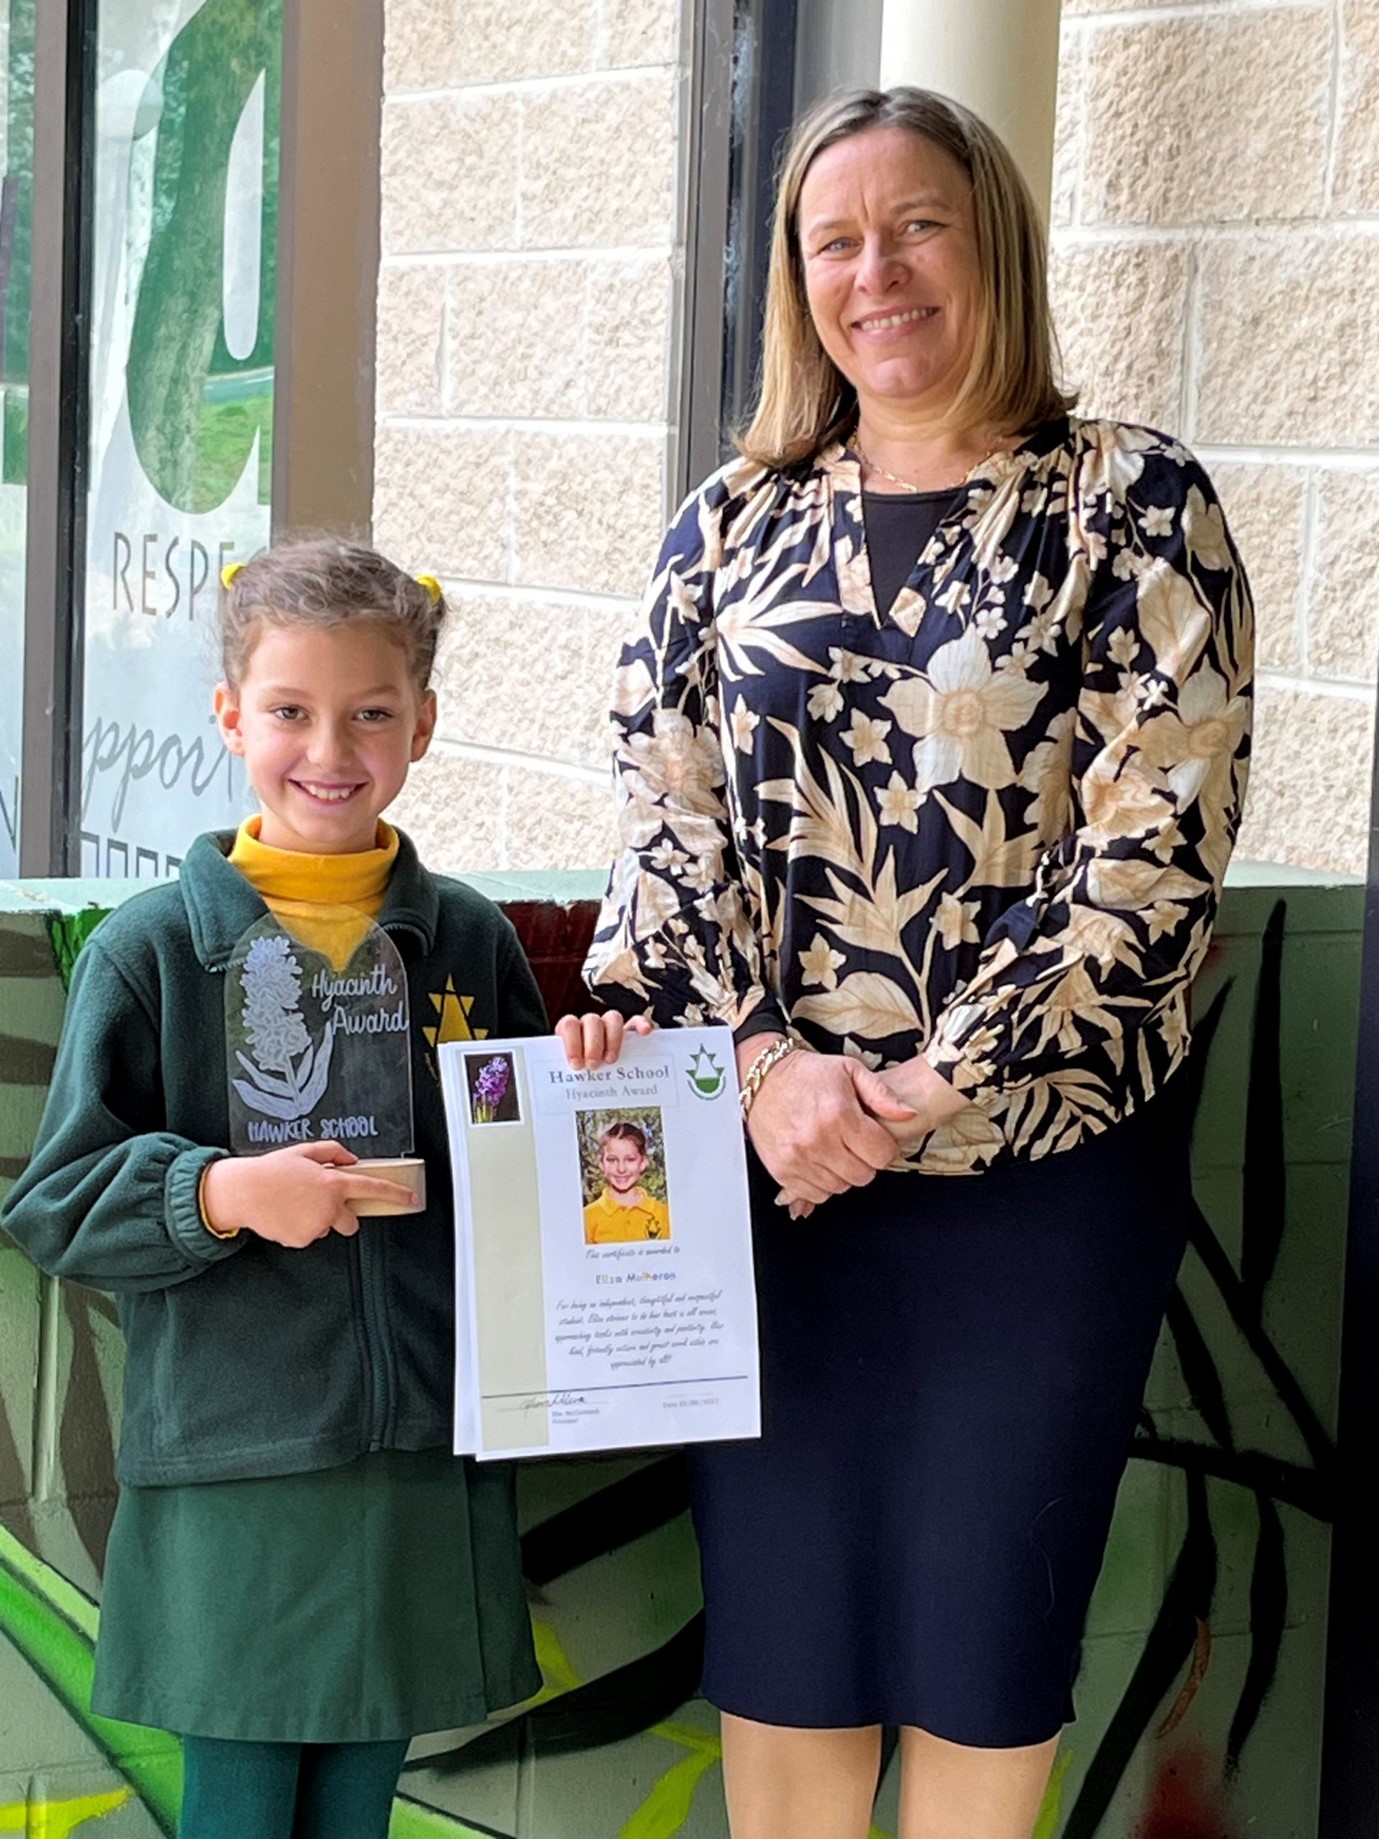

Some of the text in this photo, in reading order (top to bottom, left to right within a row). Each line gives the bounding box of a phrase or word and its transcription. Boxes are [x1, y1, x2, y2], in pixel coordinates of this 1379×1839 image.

[312, 964, 397, 1010] Hyacinth
[332, 1000, 410, 1036] Award
[549, 1065, 670, 1084] Hawker School
[565, 1084, 659, 1102] Hyacinth Award
[247, 1115, 378, 1143] HAWKER SCHOOL
